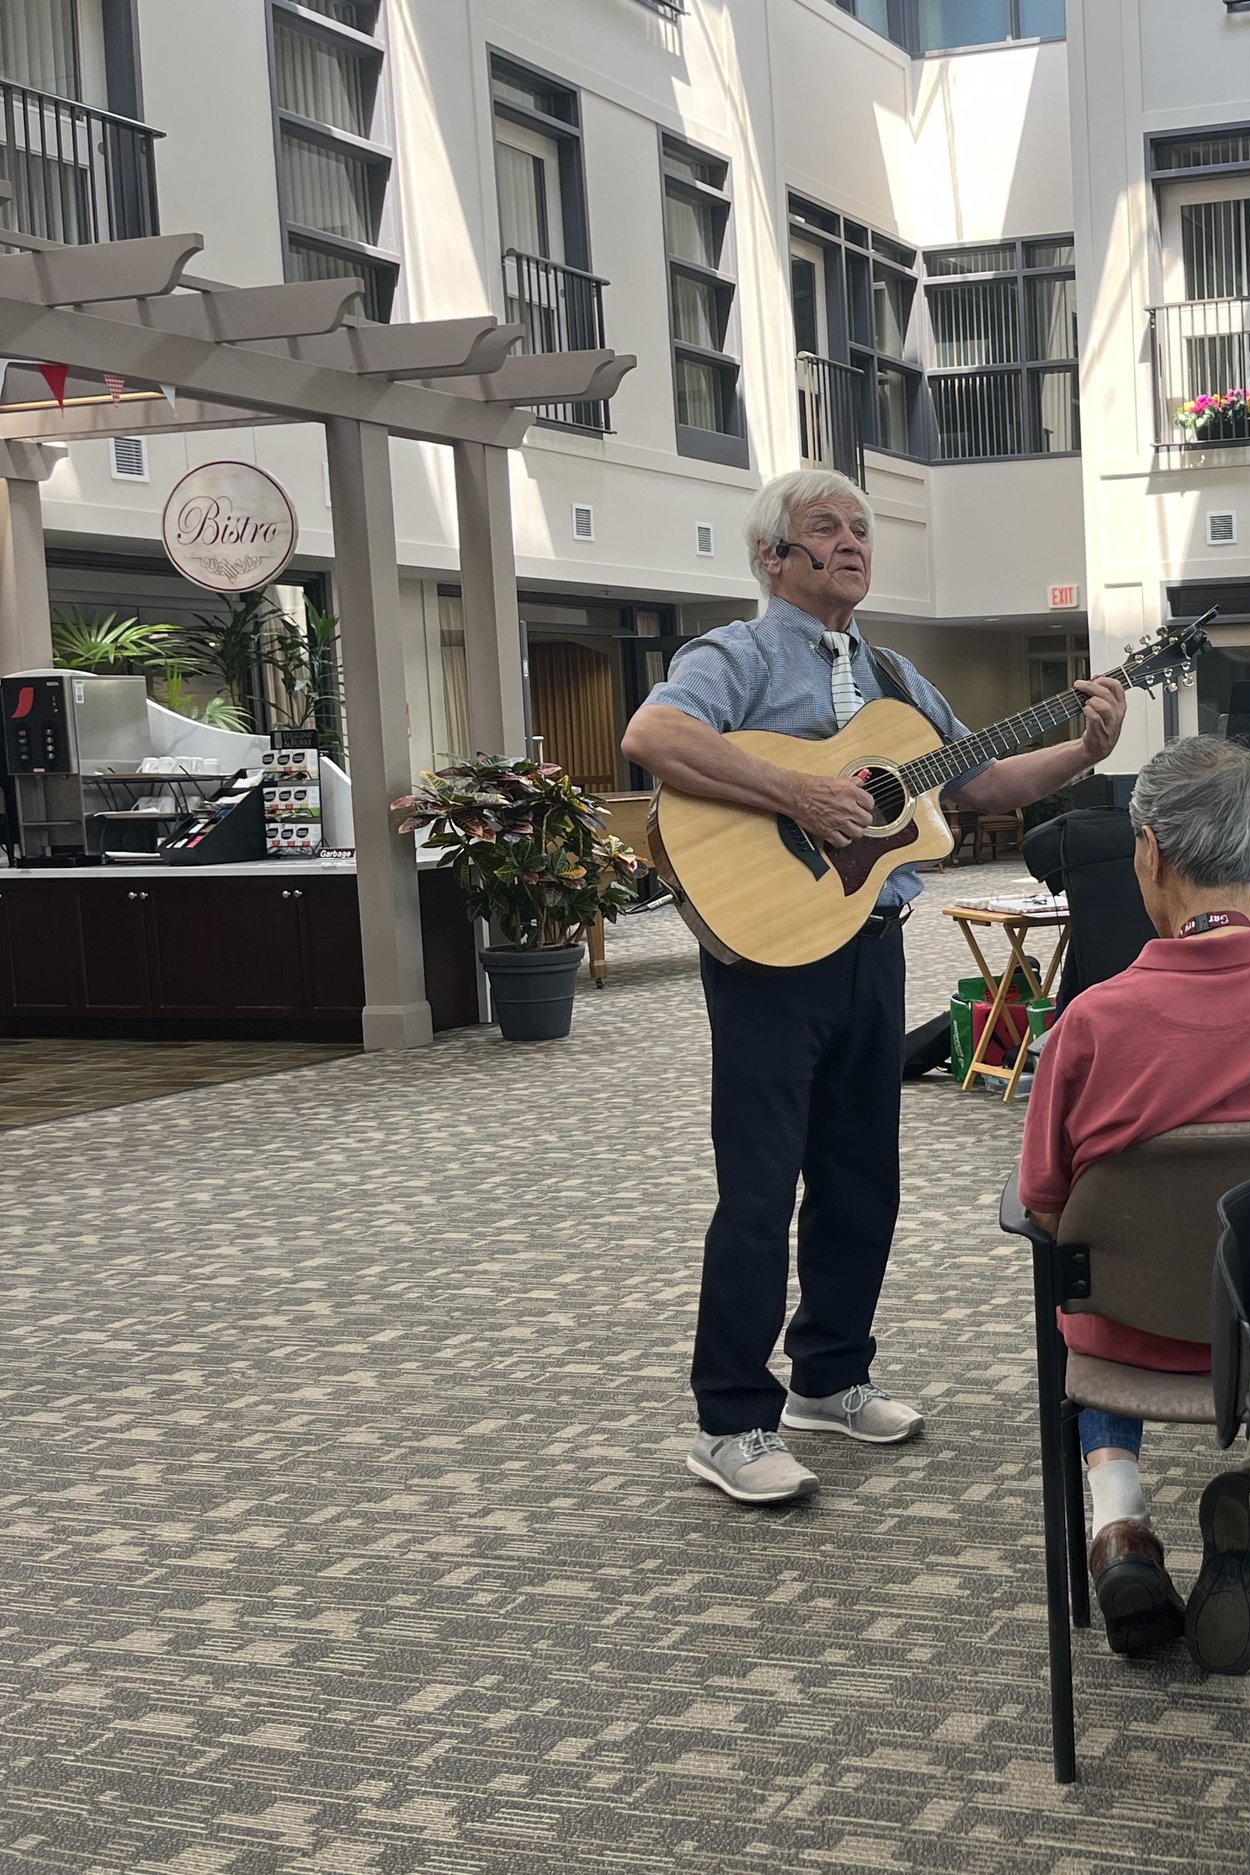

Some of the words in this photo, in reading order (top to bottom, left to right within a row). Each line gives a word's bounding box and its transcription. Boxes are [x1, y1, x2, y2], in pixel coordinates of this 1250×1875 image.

[177, 496, 278, 545] Bistro
[1052, 587, 1073, 606] EXIT
[320, 849, 352, 858] Garbage
